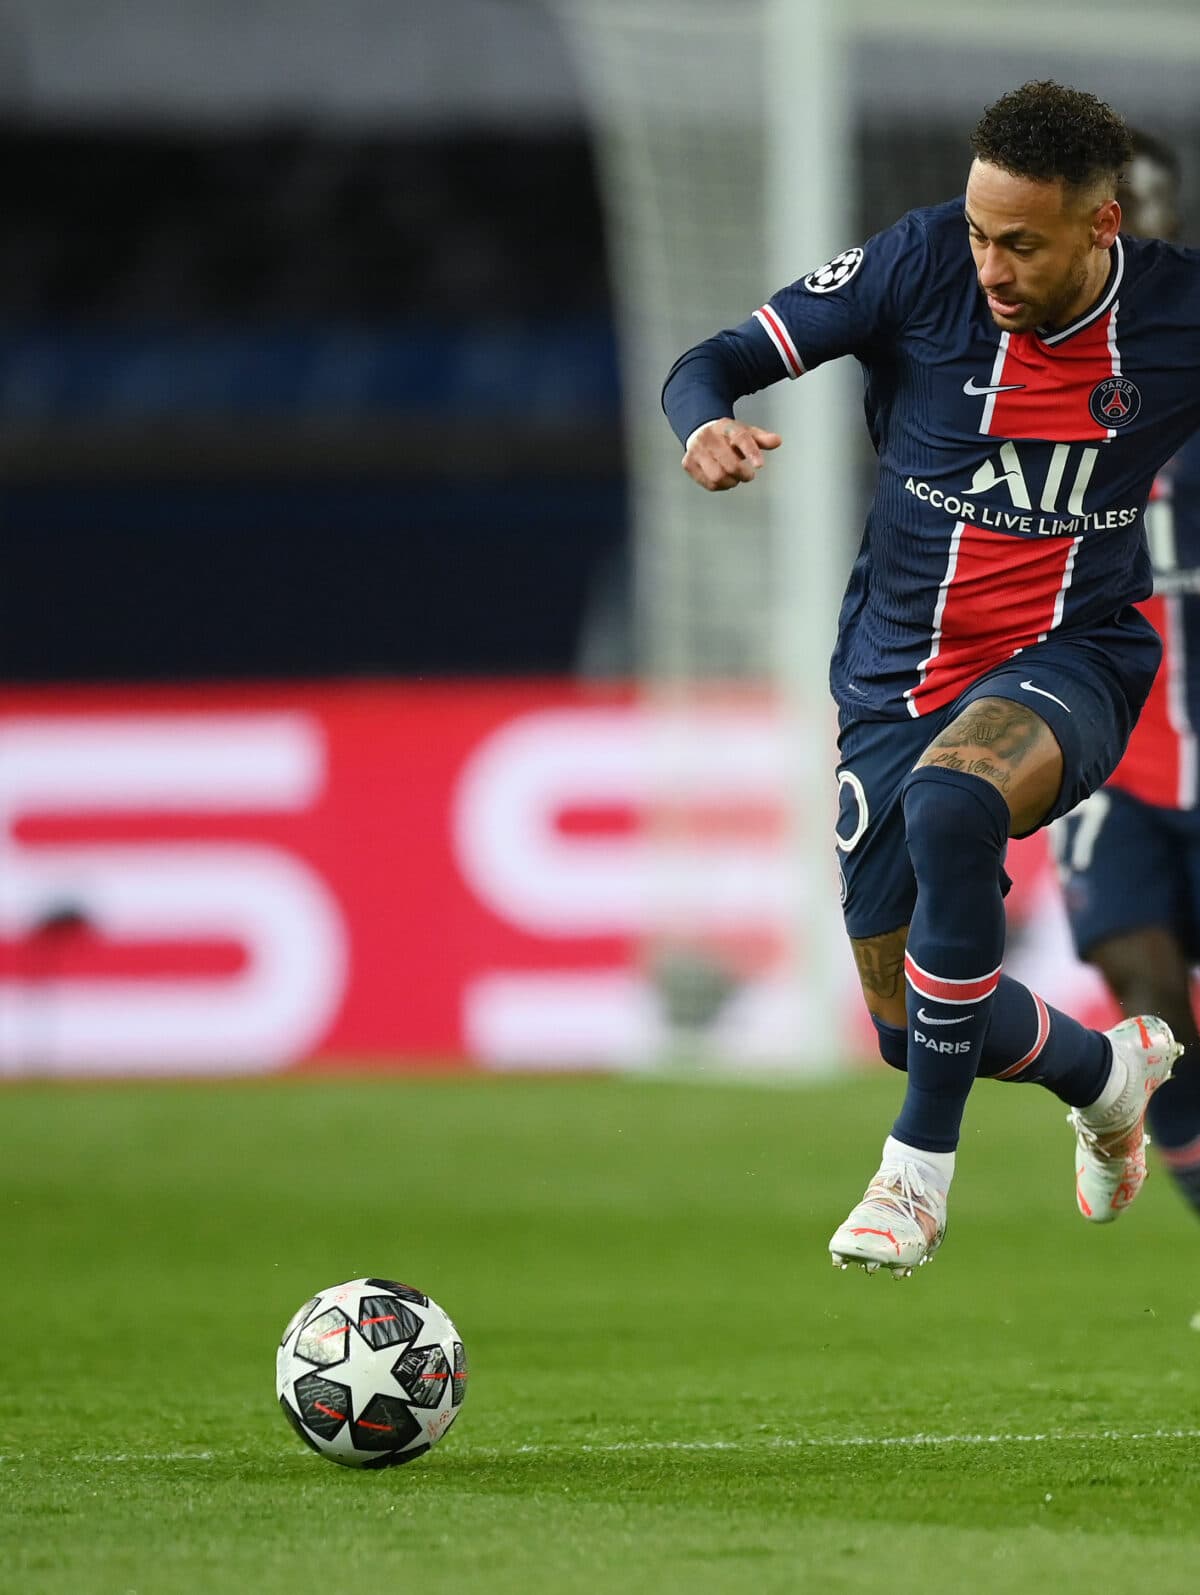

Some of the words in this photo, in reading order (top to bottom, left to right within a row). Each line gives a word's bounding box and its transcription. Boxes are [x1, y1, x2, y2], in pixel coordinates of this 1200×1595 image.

[1100, 380, 1134, 394] PARIS
[904, 476, 976, 520] ACCOR
[982, 508, 1033, 533] LIVE
[1038, 507, 1139, 536] LIMITLESS
[914, 1029, 971, 1054] PARIS
